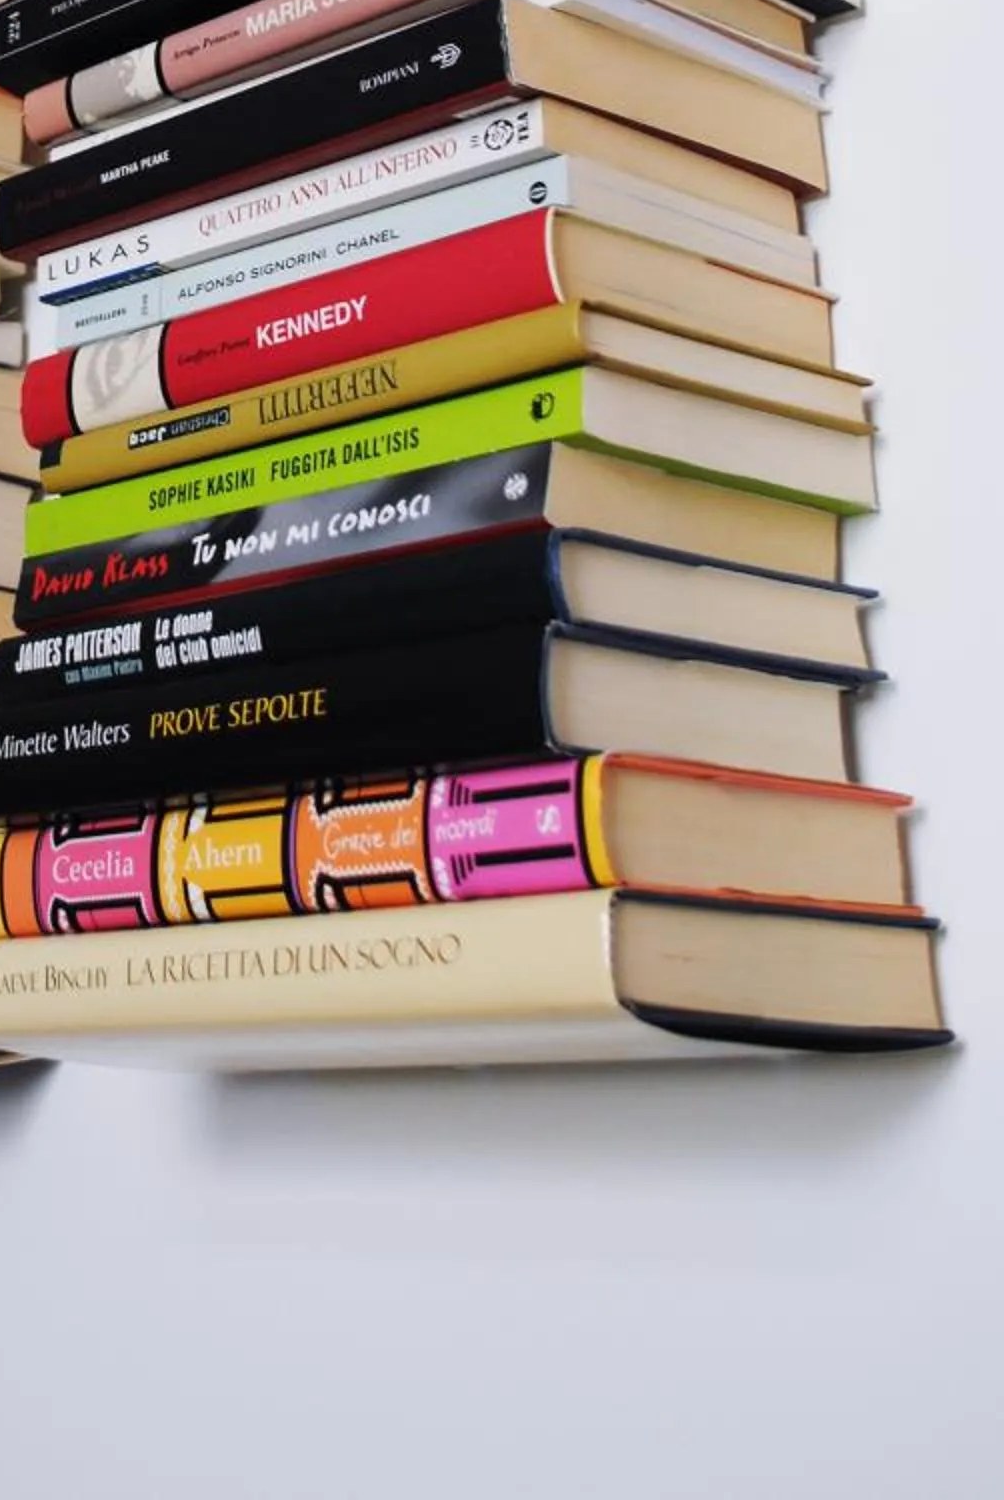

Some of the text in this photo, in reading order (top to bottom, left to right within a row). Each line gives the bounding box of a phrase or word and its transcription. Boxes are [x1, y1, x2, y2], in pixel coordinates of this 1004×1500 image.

[359, 61, 420, 93] BOMPIANI
[516, 111, 529, 144] TEA
[100, 149, 171, 185] MARTHA PEAKE
[48, 136, 459, 282] LUKAS QUATTRO ANNI ALL'INFERNO
[177, 229, 401, 302] ALFONSO SIGNORINI CHANEL
[255, 294, 368, 351] KENNEDY
[128, 359, 399, 448] Christian Jacq NEFERTITI
[148, 426, 420, 512] SOPHIE KASIKI FUGGITA DALL'ISIS
[32, 493, 432, 601] DAVID KLASS TU NON MI CONOSCI
[14, 621, 142, 674] JAMES PATTERSON
[155, 610, 214, 642] Le donne
[155, 625, 263, 669] del club omicidi
[64, 721, 131, 751] Walters
[149, 704, 221, 739] PROVE
[229, 688, 328, 727] SEPOLTE
[183, 836, 263, 871] Ahern
[323, 823, 385, 859] Grazie
[52, 852, 135, 885] Cecelia
[126, 957, 156, 987] LA
[161, 947, 268, 985] RICETTA
[272, 946, 296, 976] DI
[304, 941, 352, 974] UN
[354, 932, 463, 973] SOGNO
